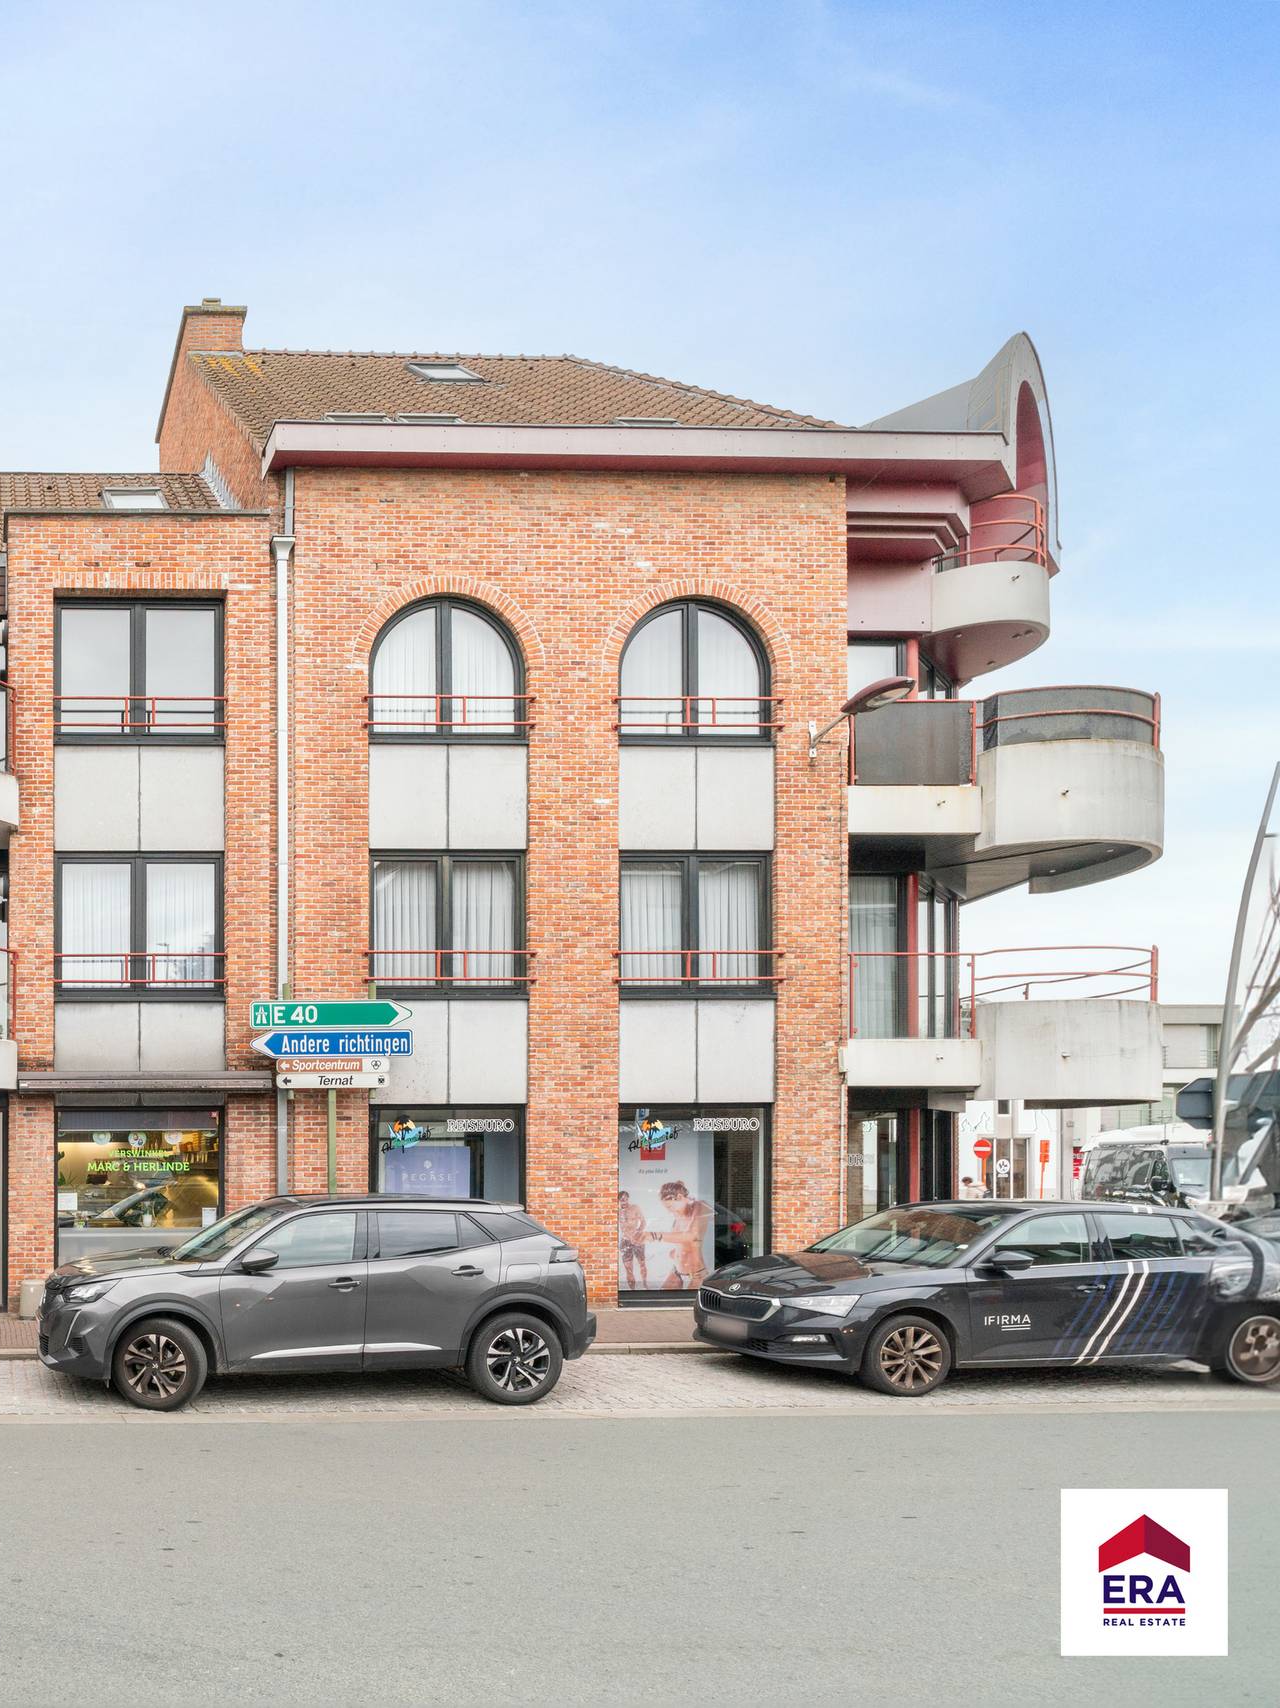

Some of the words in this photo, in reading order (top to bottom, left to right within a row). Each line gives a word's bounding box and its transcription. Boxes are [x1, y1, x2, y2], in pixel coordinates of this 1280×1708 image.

[273, 1005, 286, 1024] E
[290, 1005, 318, 1024] 40
[281, 1035, 330, 1053] Andere
[339, 1034, 408, 1056] richtingen
[292, 1060, 360, 1072] Sportcentrum
[317, 1075, 354, 1086] Ternat
[446, 1118, 515, 1133] REISBURO
[692, 1117, 760, 1132] REISBURO
[87, 1161, 121, 1172] MARC
[123, 1162, 131, 1172] &
[133, 1161, 190, 1172] HERLINDE
[984, 1314, 1031, 1326] IFIRMA
